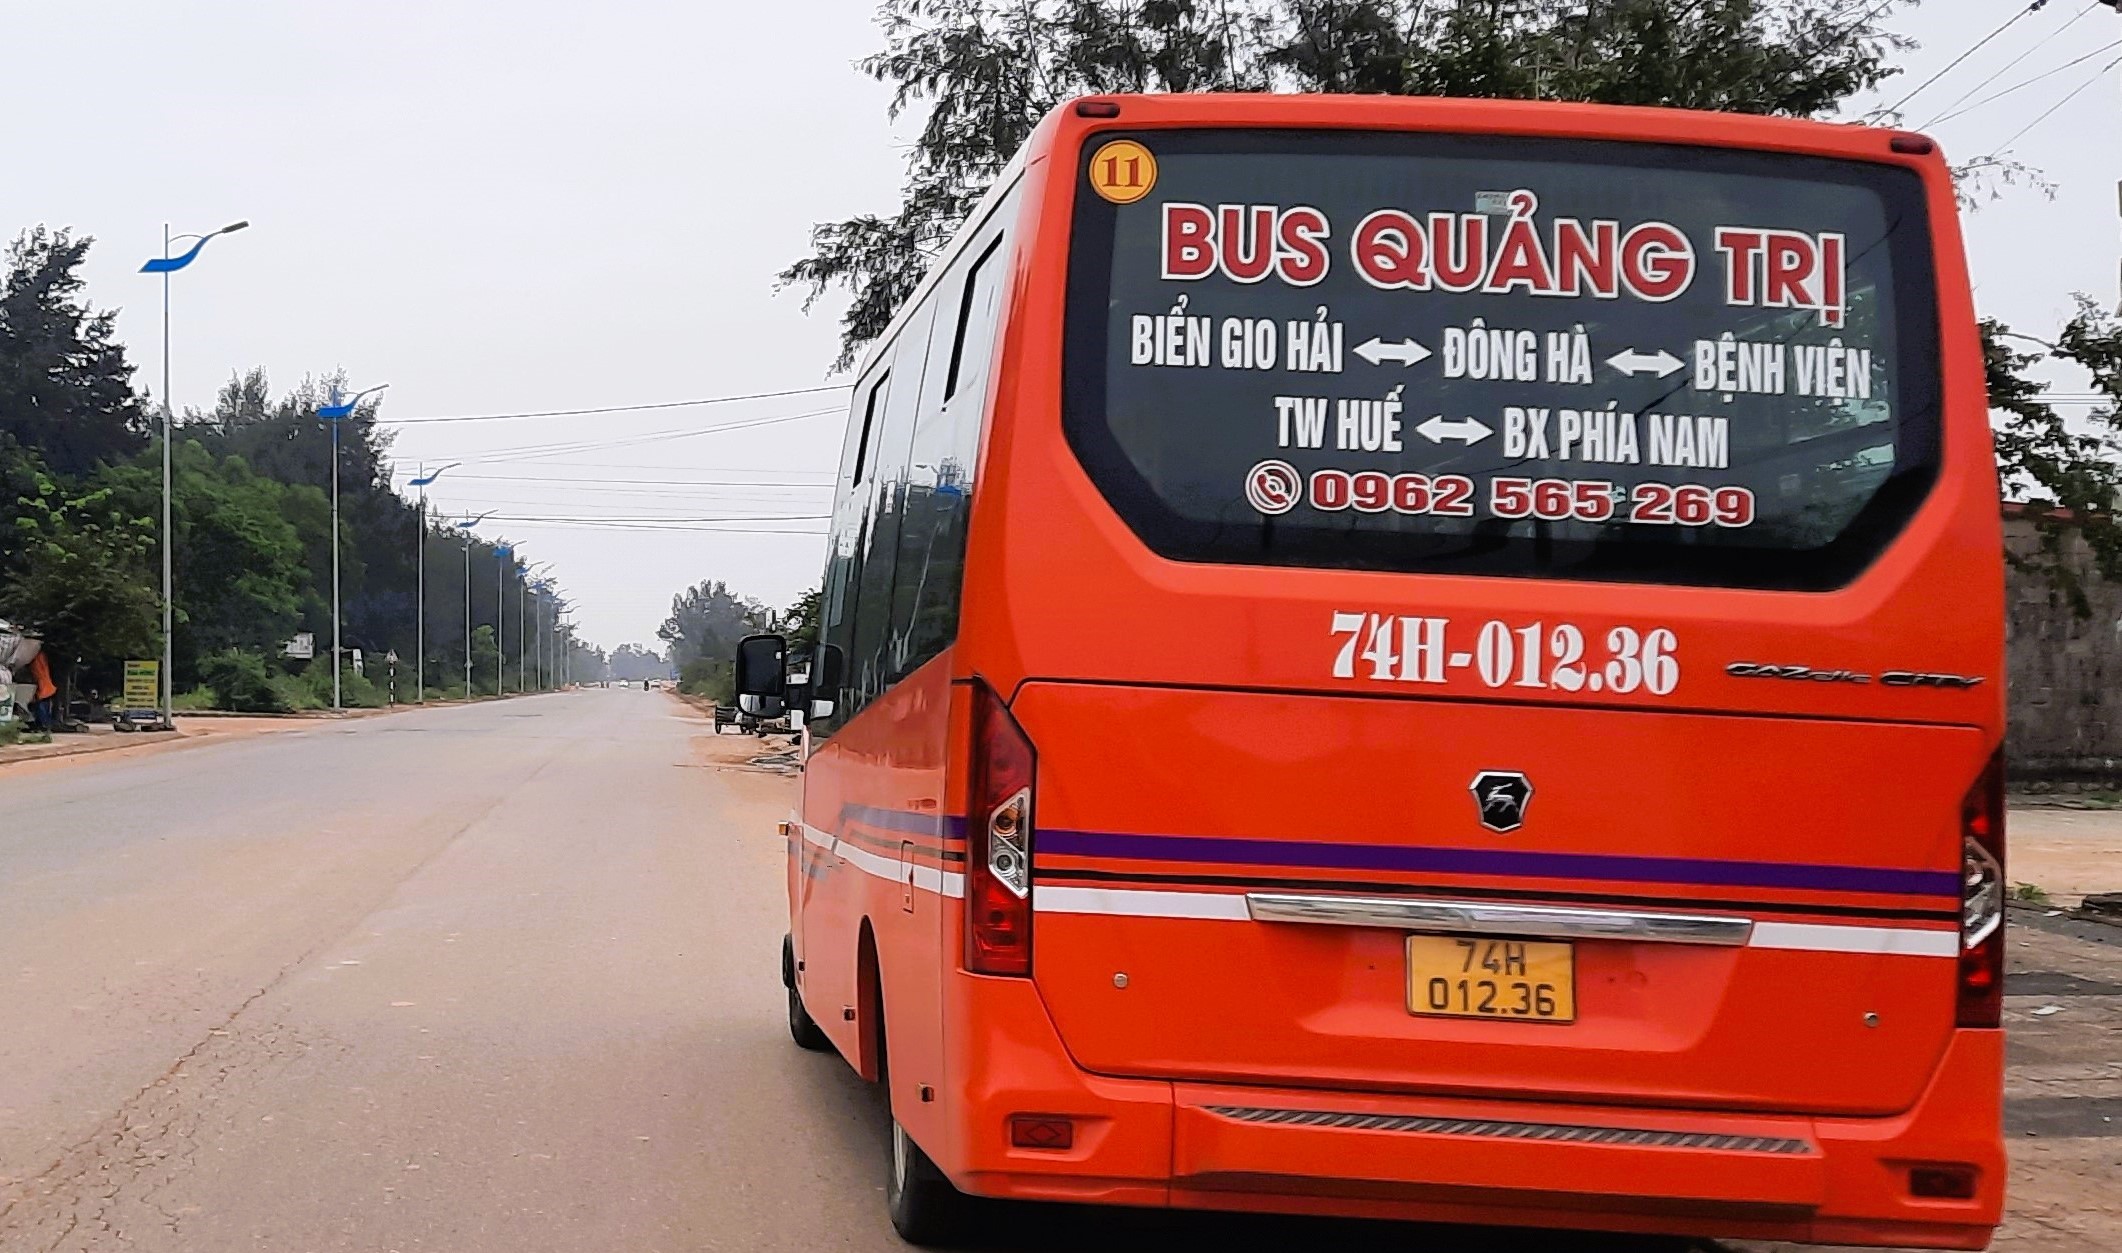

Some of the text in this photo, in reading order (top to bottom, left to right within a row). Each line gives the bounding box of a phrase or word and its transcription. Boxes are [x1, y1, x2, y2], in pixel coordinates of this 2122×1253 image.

[1102, 155, 1143, 187] 11
[1161, 188, 1845, 328] BUS QUẢNG TRỊ
[1131, 294, 1871, 406] BIỂN GIO HẢI ĐÔNG HÀ BỆNH VIỆN
[1274, 384, 1730, 468] TW HUẾ BX PHÍA NAM
[1309, 469, 1755, 528] 0962 565 269
[1330, 610, 1680, 695] 74H-012.36
[1456, 939, 1527, 976] 74H
[1429, 977, 1556, 1016] 012.36
